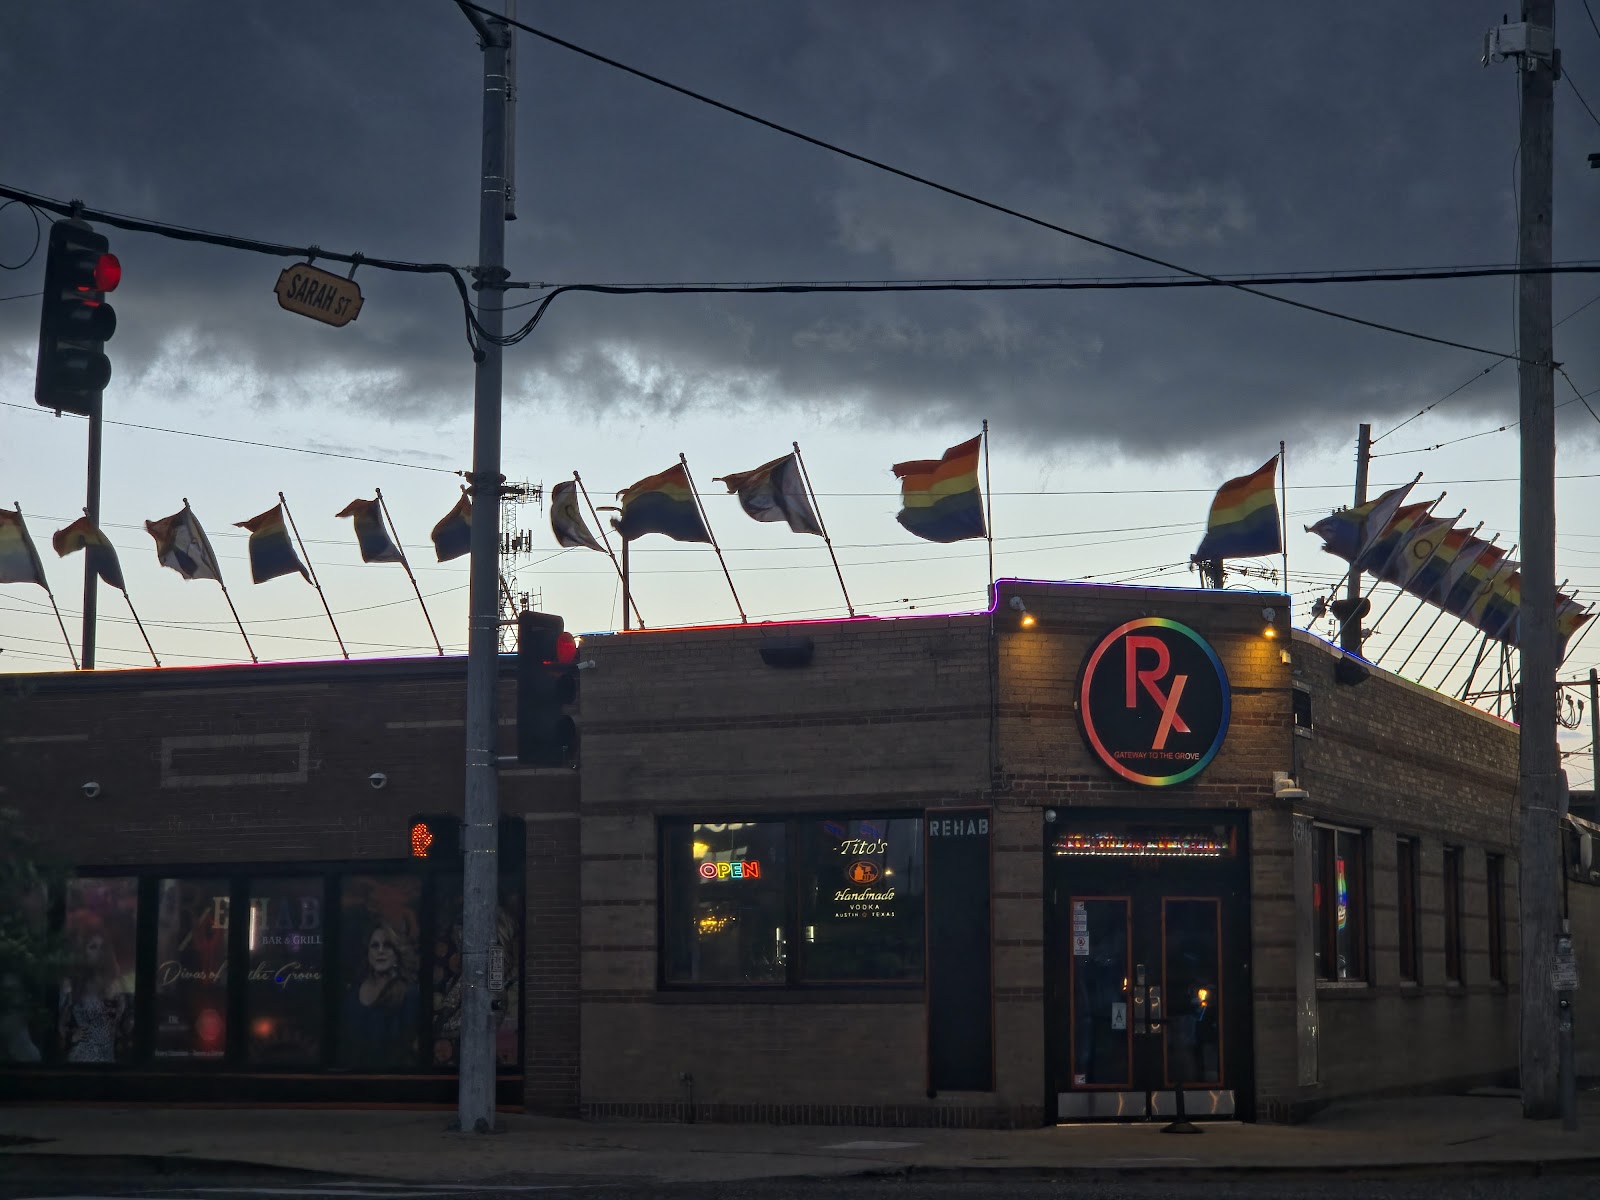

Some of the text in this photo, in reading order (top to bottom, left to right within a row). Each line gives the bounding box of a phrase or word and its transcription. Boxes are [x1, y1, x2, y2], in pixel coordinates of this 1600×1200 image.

[287, 273, 352, 317] SARAH ST
[1113, 751, 1147, 759] GATEWAY
[1159, 752, 1173, 760] THE
[1174, 752, 1200, 760] GROVE
[929, 818, 989, 837] REHAB
[840, 838, 888, 855] Tito's
[699, 860, 761, 879] OPEN
[833, 887, 895, 901] Handmade
[262, 935, 323, 945] BAR & GRILL
[158, 960, 207, 988] Divas
[248, 961, 275, 981] the
[274, 961, 322, 989] Grove
